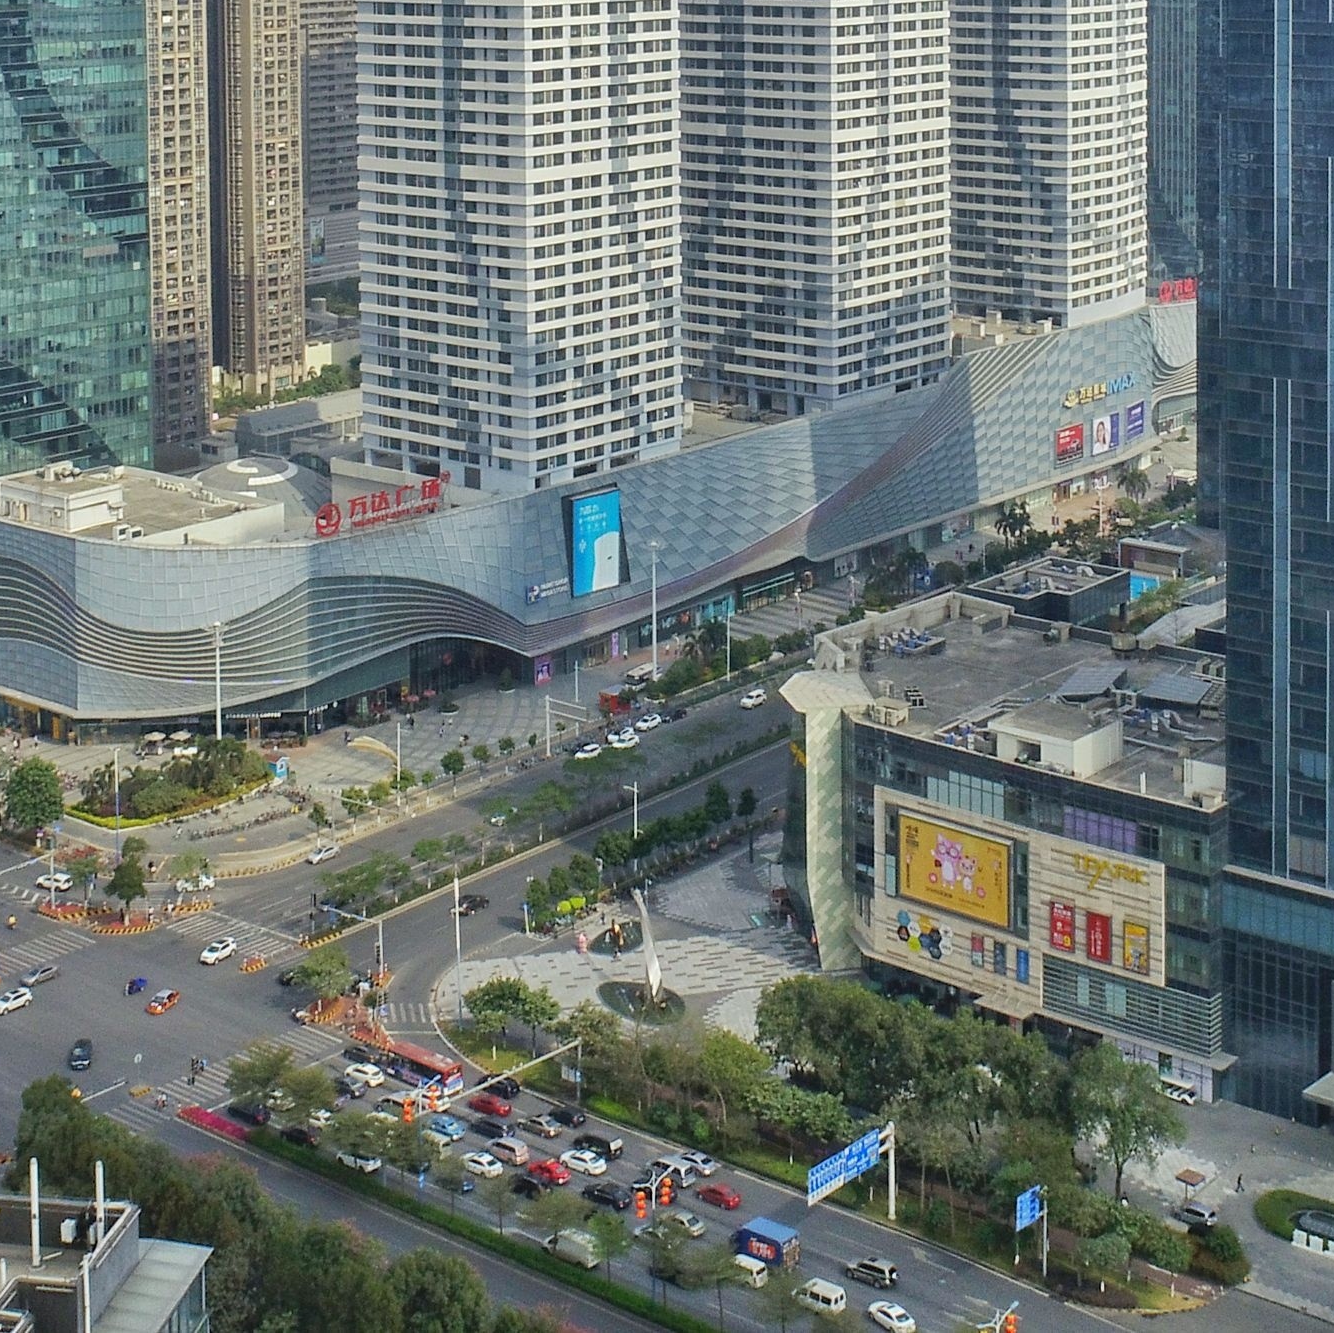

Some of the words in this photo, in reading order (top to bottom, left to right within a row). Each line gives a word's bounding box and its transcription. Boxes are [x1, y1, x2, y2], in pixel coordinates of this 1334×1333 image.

[1108, 372, 1137, 395] IMAX
[348, 477, 441, 518] 万达广场
